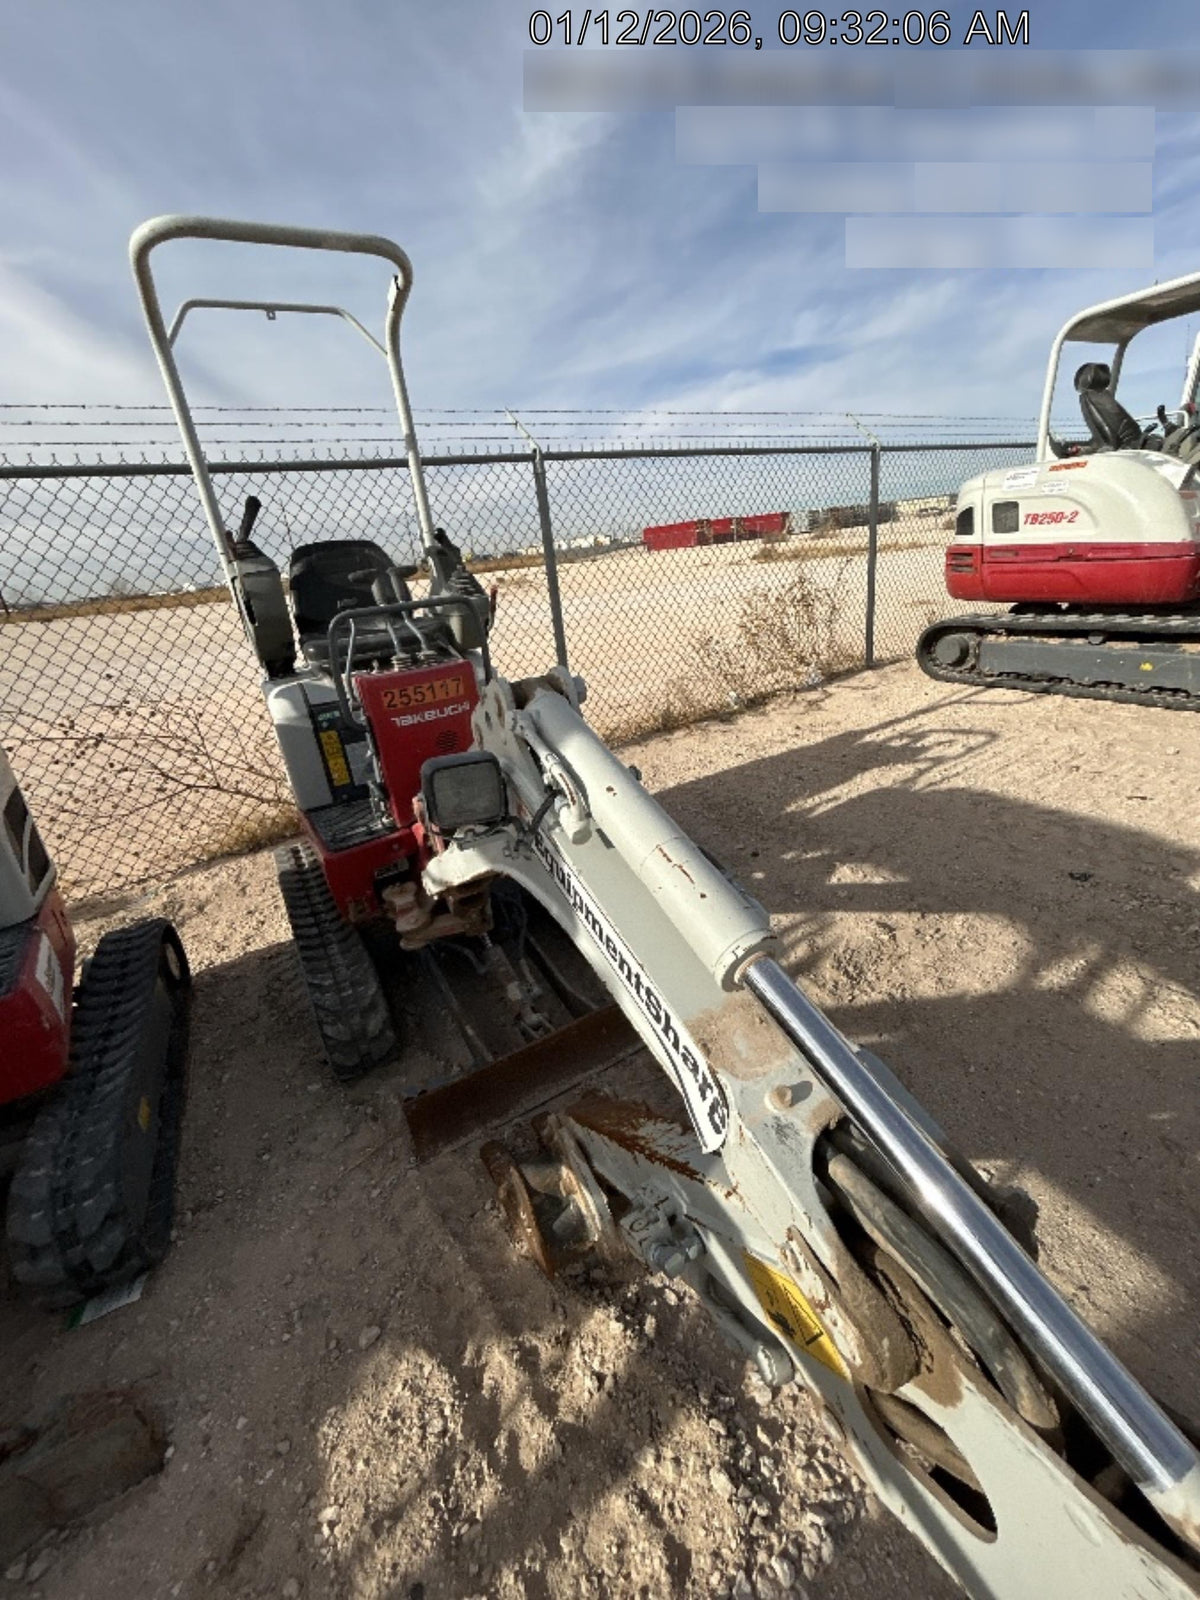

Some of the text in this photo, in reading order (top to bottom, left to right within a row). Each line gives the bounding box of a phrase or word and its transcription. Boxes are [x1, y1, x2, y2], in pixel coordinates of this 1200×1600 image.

[1023, 510, 1079, 525] TB250-2
[383, 677, 461, 708] 255117
[534, 833, 727, 1135] EquipmentShare
